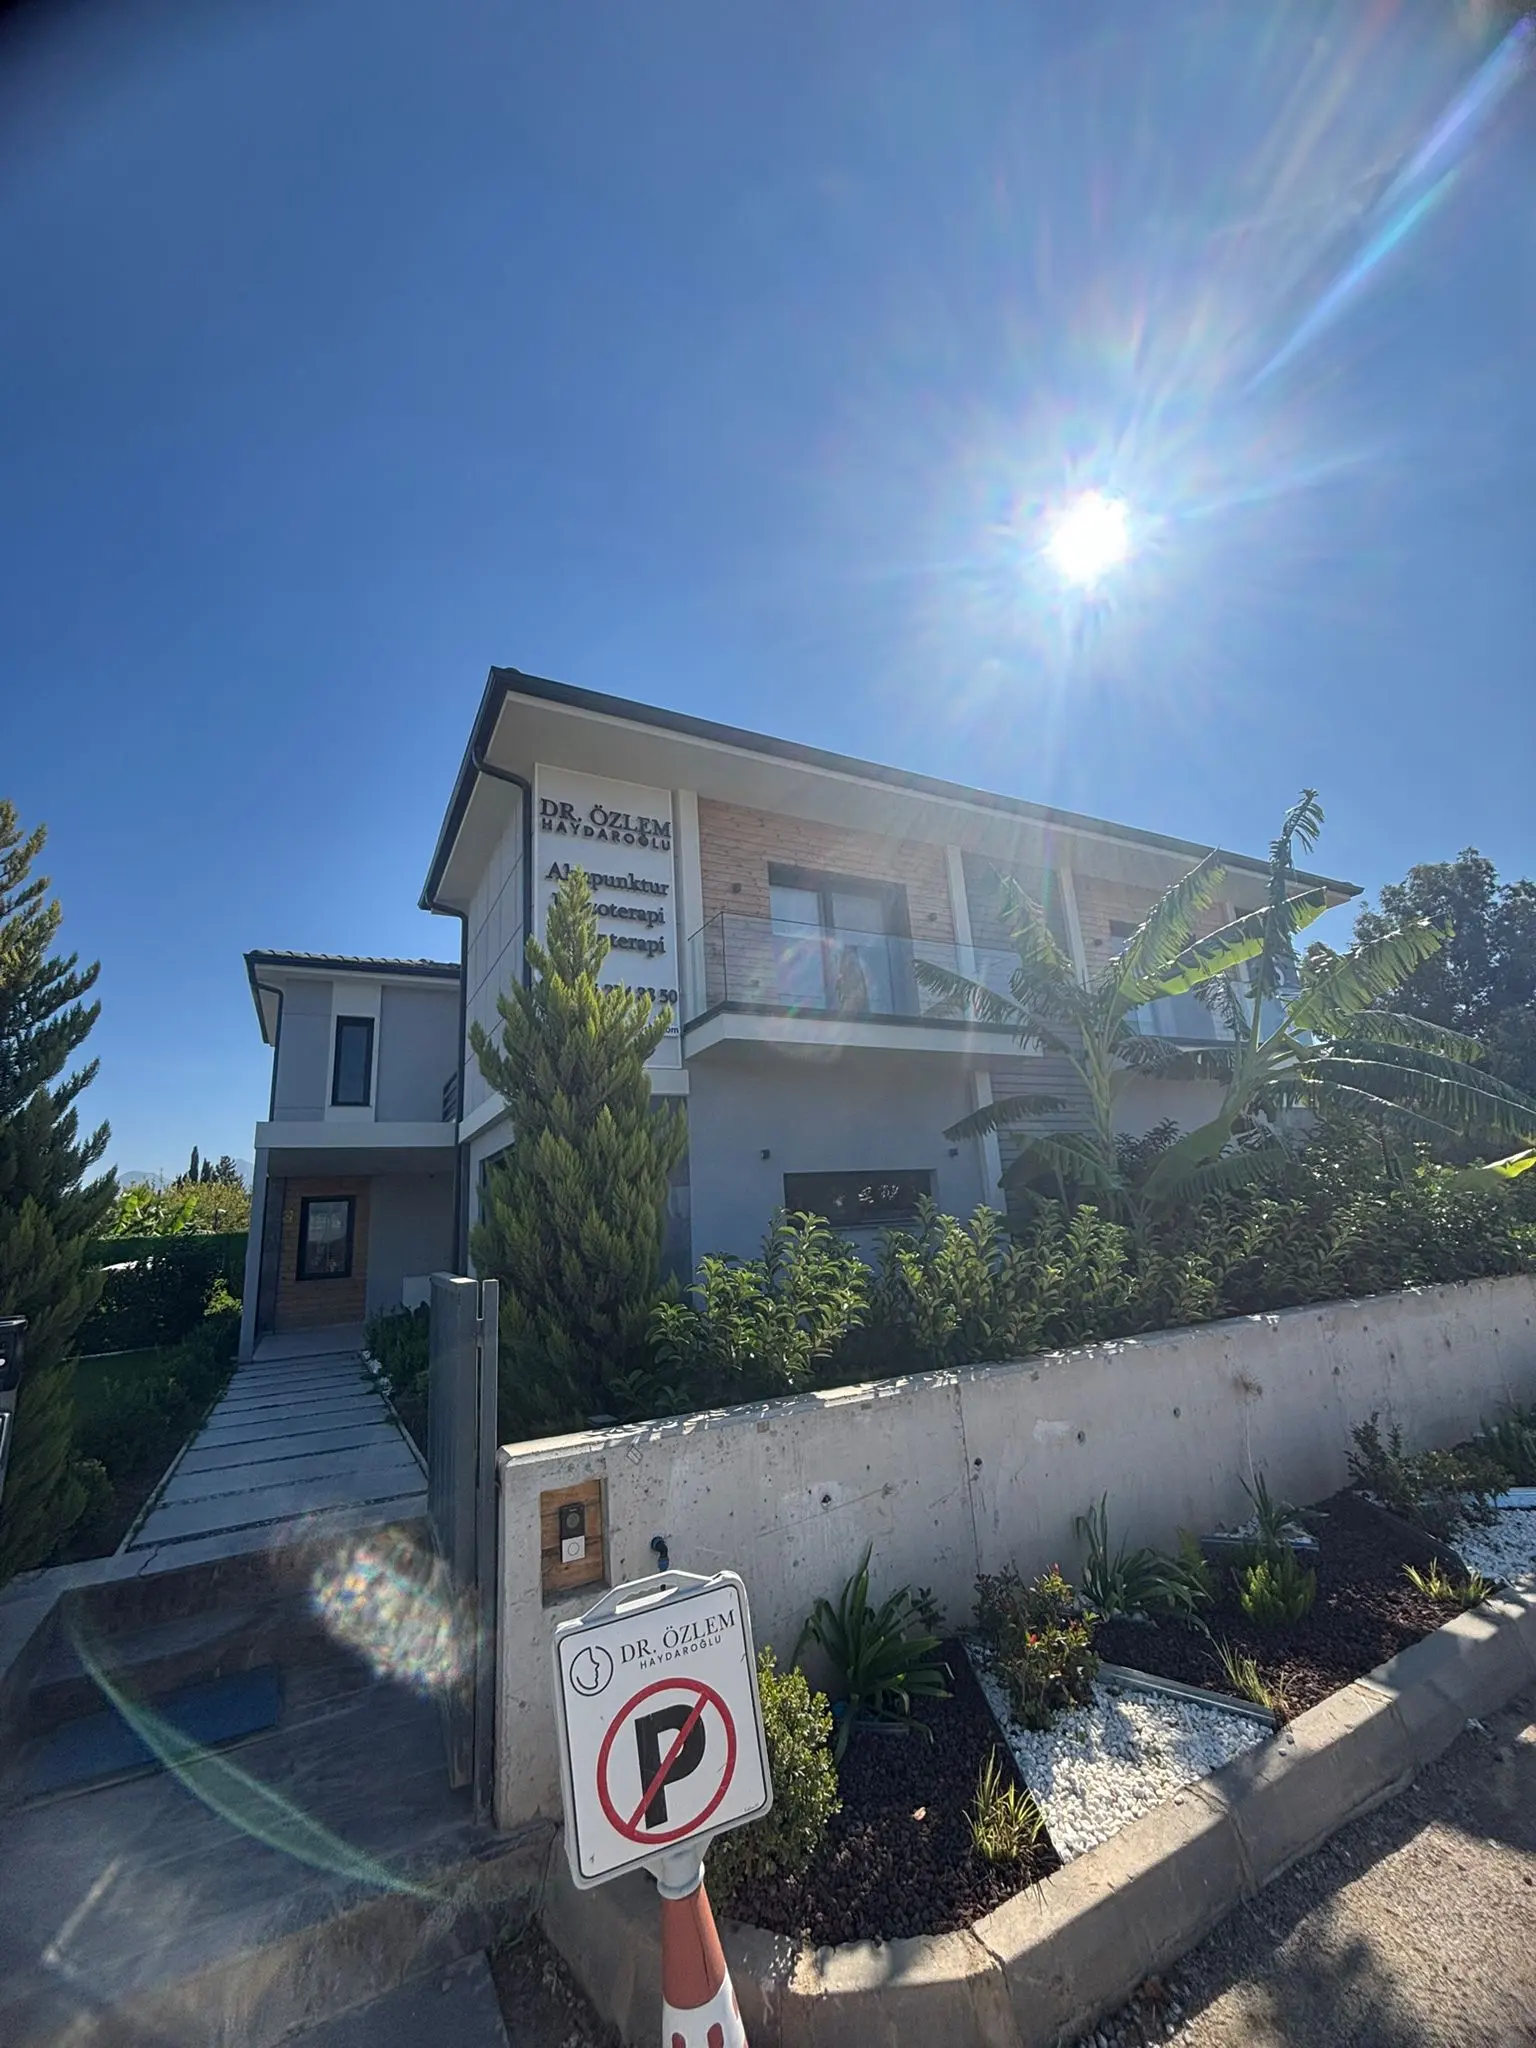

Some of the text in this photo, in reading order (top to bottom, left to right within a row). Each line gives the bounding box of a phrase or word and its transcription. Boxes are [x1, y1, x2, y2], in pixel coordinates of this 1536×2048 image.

[540, 798, 672, 839] DR. ÖZLEM
[541, 817, 671, 851] HAYDAROĞLU
[620, 1608, 736, 1665] DR. ÖZLEM
[639, 1634, 722, 1670] HAYDAROĞLU
[634, 1703, 706, 1830] P
